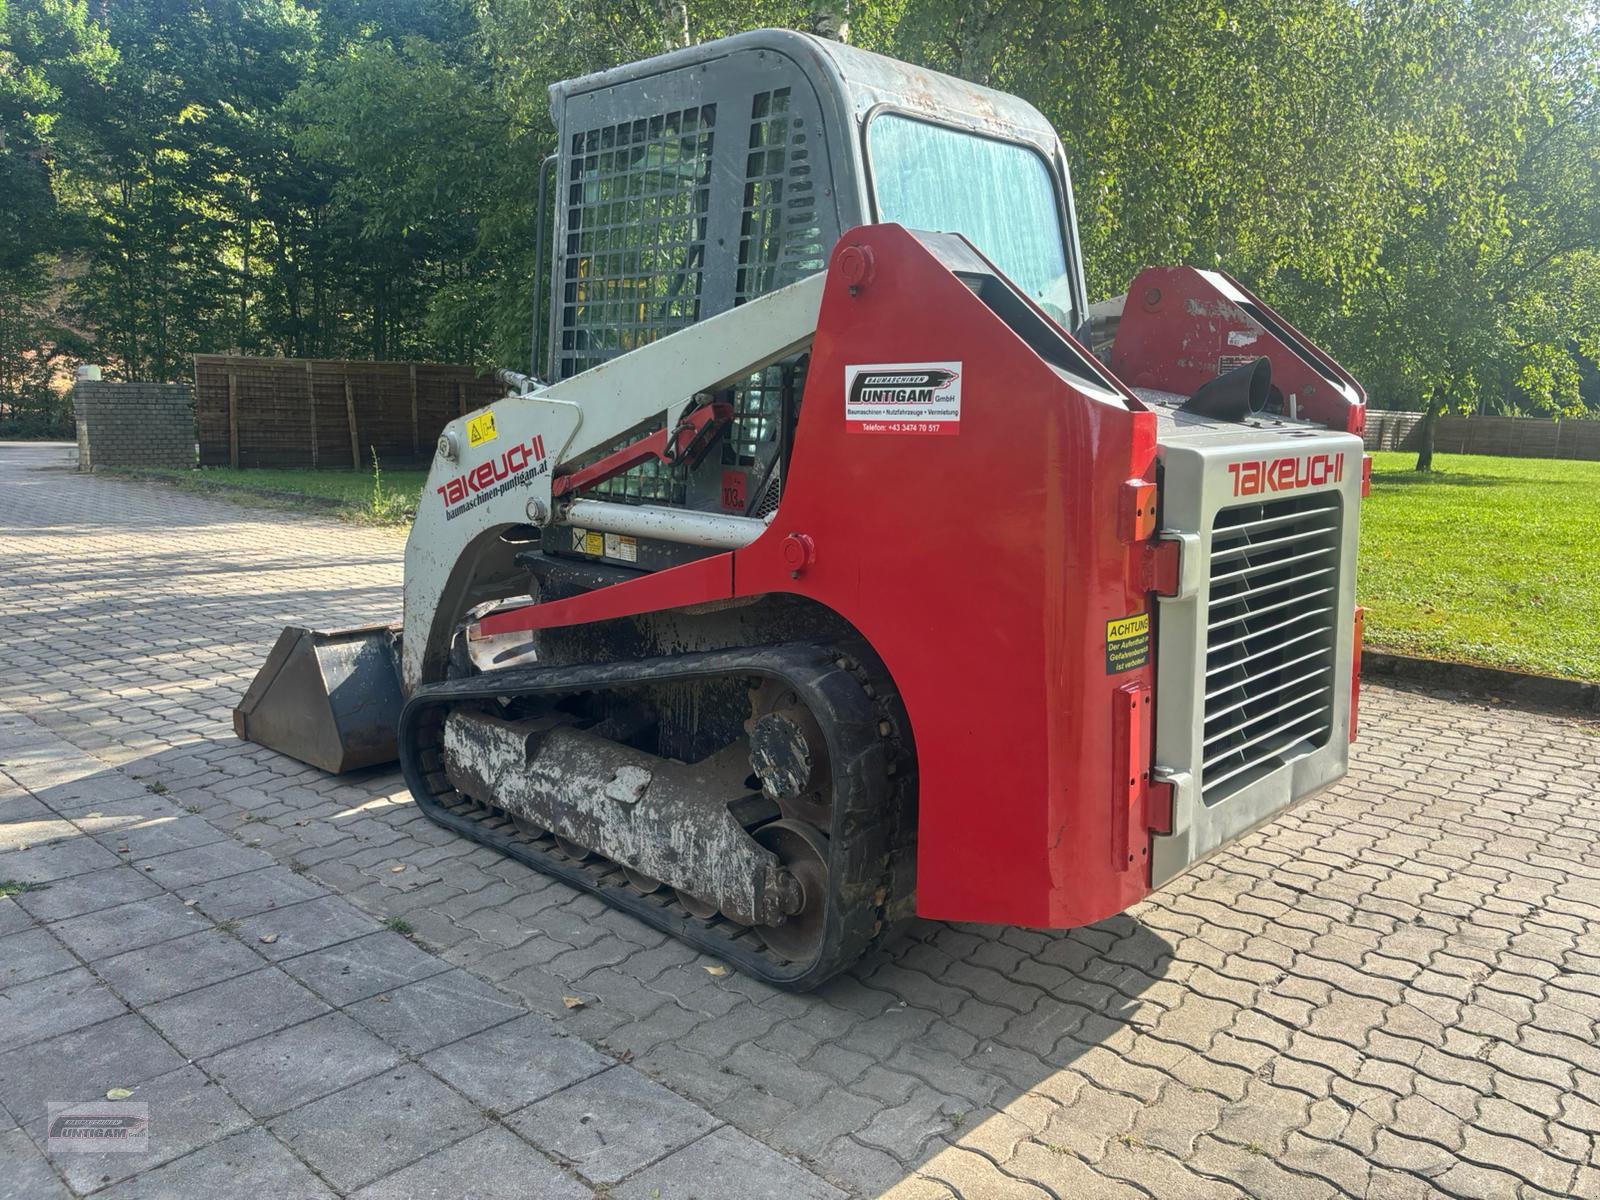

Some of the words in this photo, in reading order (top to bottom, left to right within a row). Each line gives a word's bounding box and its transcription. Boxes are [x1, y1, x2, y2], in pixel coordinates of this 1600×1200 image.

[935, 394, 955, 403] GmbH
[886, 409, 924, 417] Nutzfahrzeuge
[928, 409, 959, 417] Vermietung
[862, 423, 887, 431] Telefon:
[901, 424, 917, 432] 3474
[918, 424, 927, 432] 70
[928, 424, 940, 432] 517
[446, 460, 548, 521] baumaschinen-puntigam.at
[1108, 643, 1120, 651] Der
[1116, 662, 1124, 671] ist
